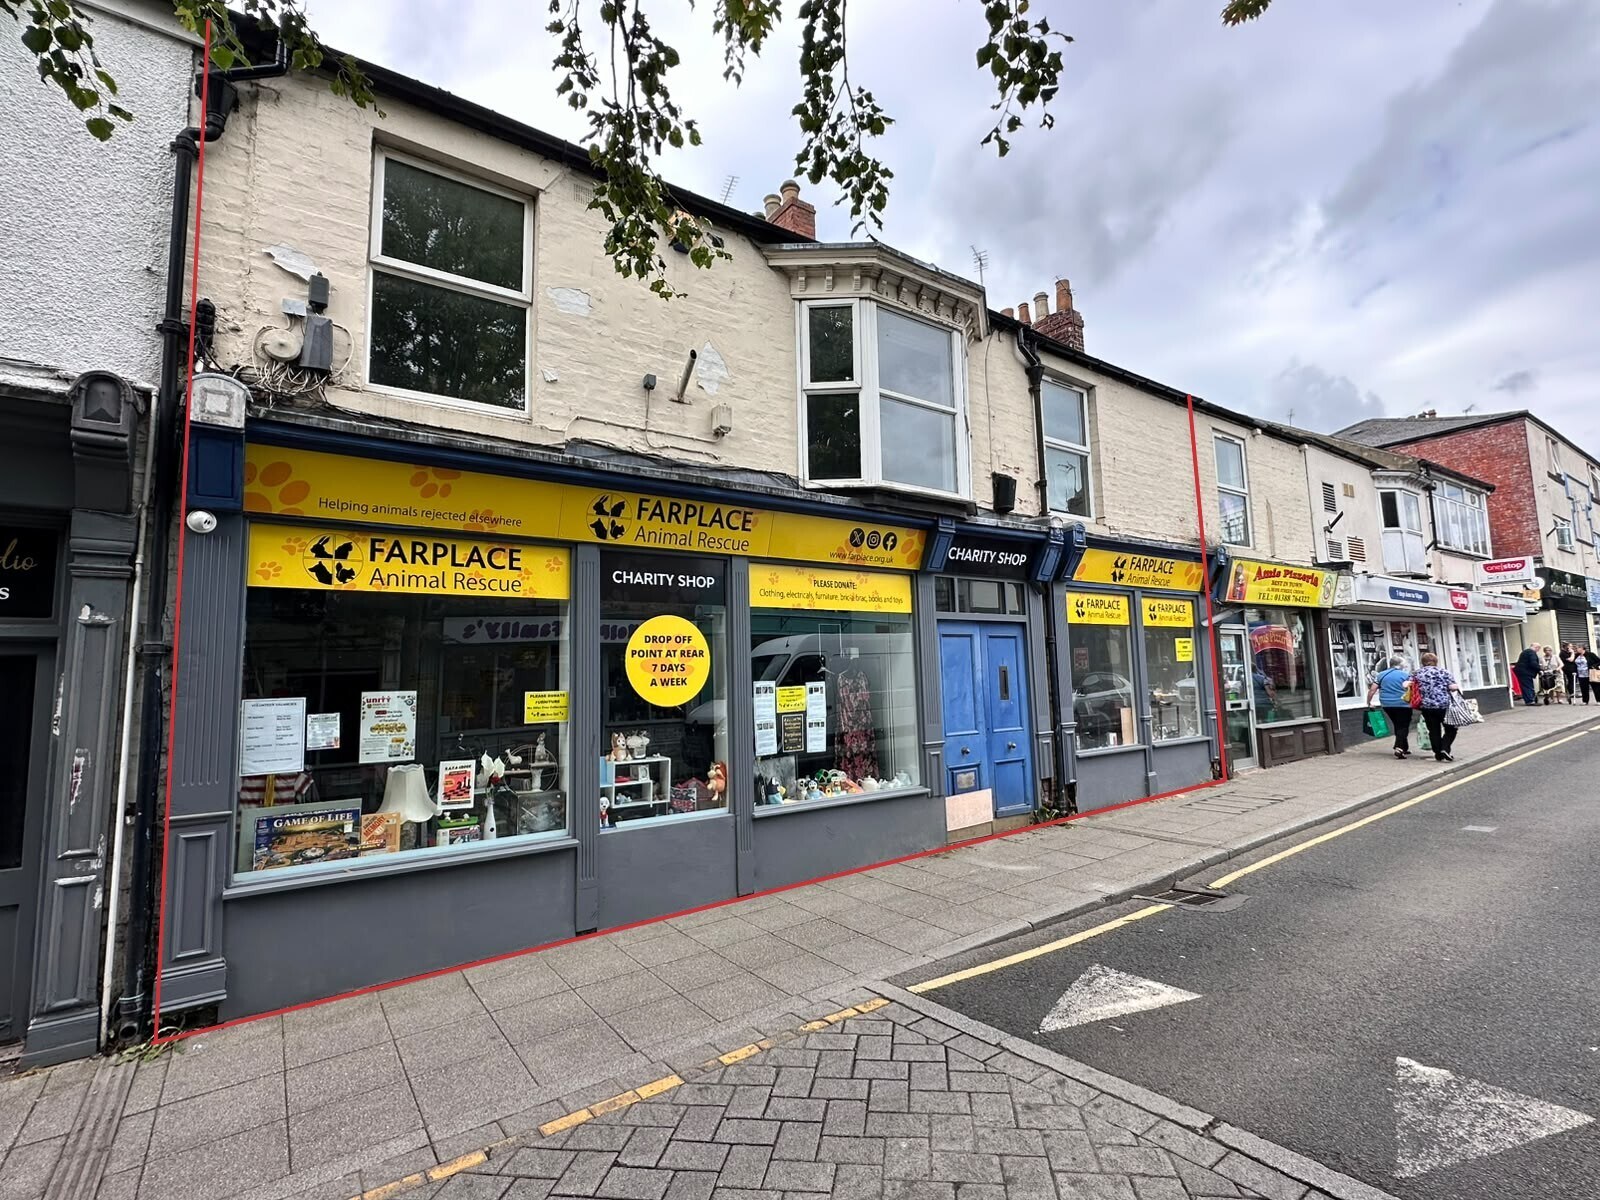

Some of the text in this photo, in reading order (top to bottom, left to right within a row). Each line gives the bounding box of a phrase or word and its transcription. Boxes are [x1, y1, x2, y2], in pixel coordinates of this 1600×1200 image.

[318, 497, 522, 527] Helping animals rejected elsewhere
[636, 498, 754, 532] FARPLACE
[634, 525, 750, 552] Animal Rescue
[369, 538, 522, 571] FARPLACE
[829, 551, 894, 564] www.farplace.org.uk
[948, 546, 1027, 567] CHARITY SHOP
[1129, 556, 1175, 575] FARPLACE
[369, 568, 522, 593] Animal Rescue
[612, 570, 715, 589] CHARITY SHOP
[813, 579, 857, 590] PLEASE DONATE:
[1126, 573, 1170, 587] Animal Rescue
[759, 588, 785, 600] Clothing,
[786, 591, 814, 601] electricals,
[868, 595, 883, 603] books
[883, 595, 892, 604] and
[1258, 592, 1273, 601] TEL:
[1086, 598, 1120, 610] FARPLACE
[1157, 603, 1186, 614] FARPLACE
[1088, 611, 1121, 620] Animal Rescue
[644, 635, 692, 644] DROP OFF
[631, 649, 704, 658] POINT AT REAR
[651, 663, 686, 672] 7 DAYS
[650, 677, 687, 687] A WEEK
[273, 812, 353, 828] GAME OF LIFE
[363, 815, 386, 838] MEMORY
